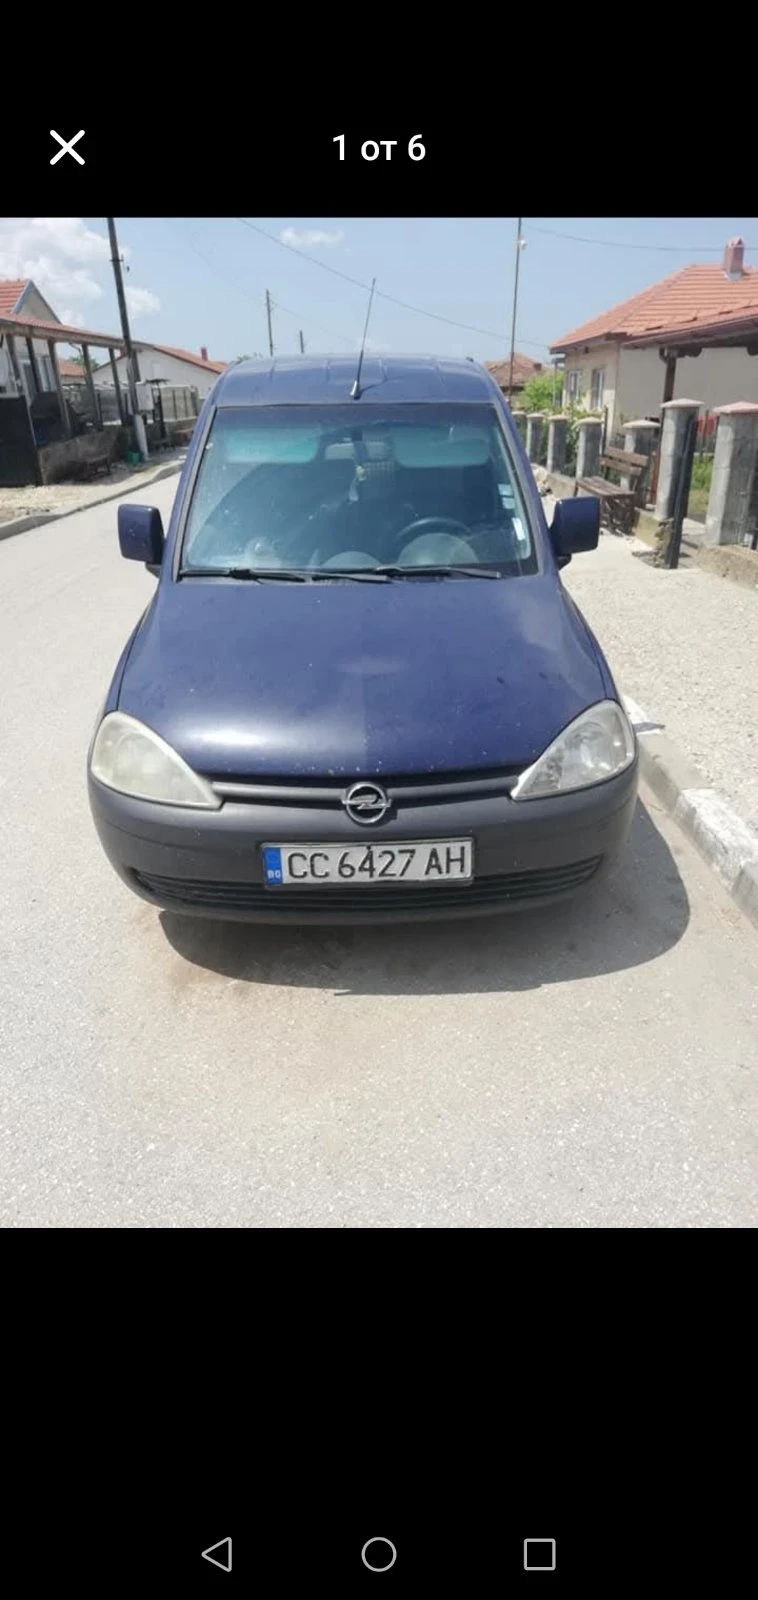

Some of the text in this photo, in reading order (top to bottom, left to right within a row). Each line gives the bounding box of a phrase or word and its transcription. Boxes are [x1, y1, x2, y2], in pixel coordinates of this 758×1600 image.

[287, 846, 465, 879] CC 6427 AH
[267, 870, 282, 880] BG
